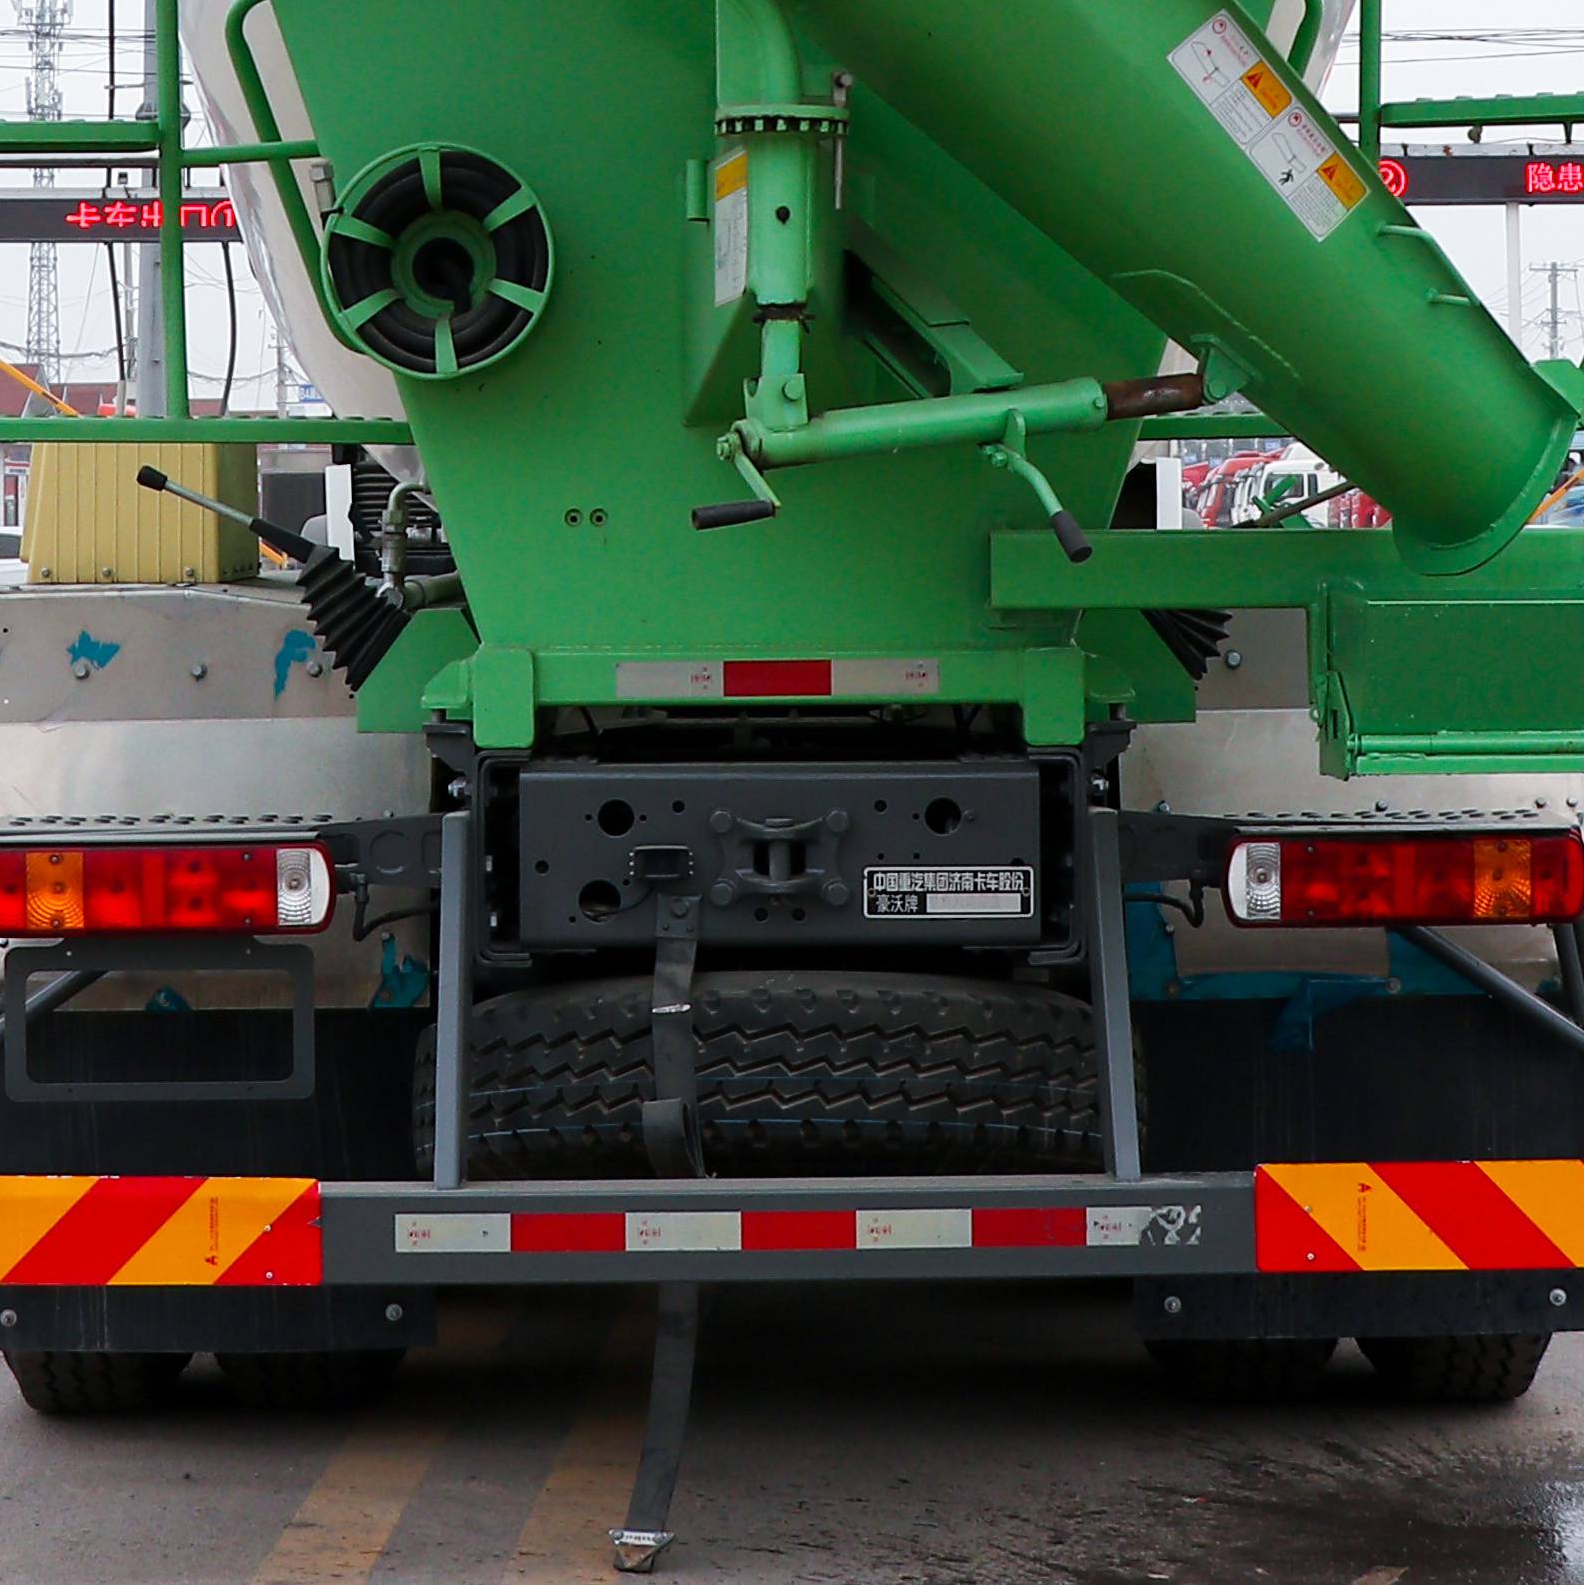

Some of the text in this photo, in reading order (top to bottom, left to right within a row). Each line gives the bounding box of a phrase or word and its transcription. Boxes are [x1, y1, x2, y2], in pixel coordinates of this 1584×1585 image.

[873, 871, 1025, 892] 中国重汽集团济南卡车股份
[876, 893, 919, 913] 豪沃牌
